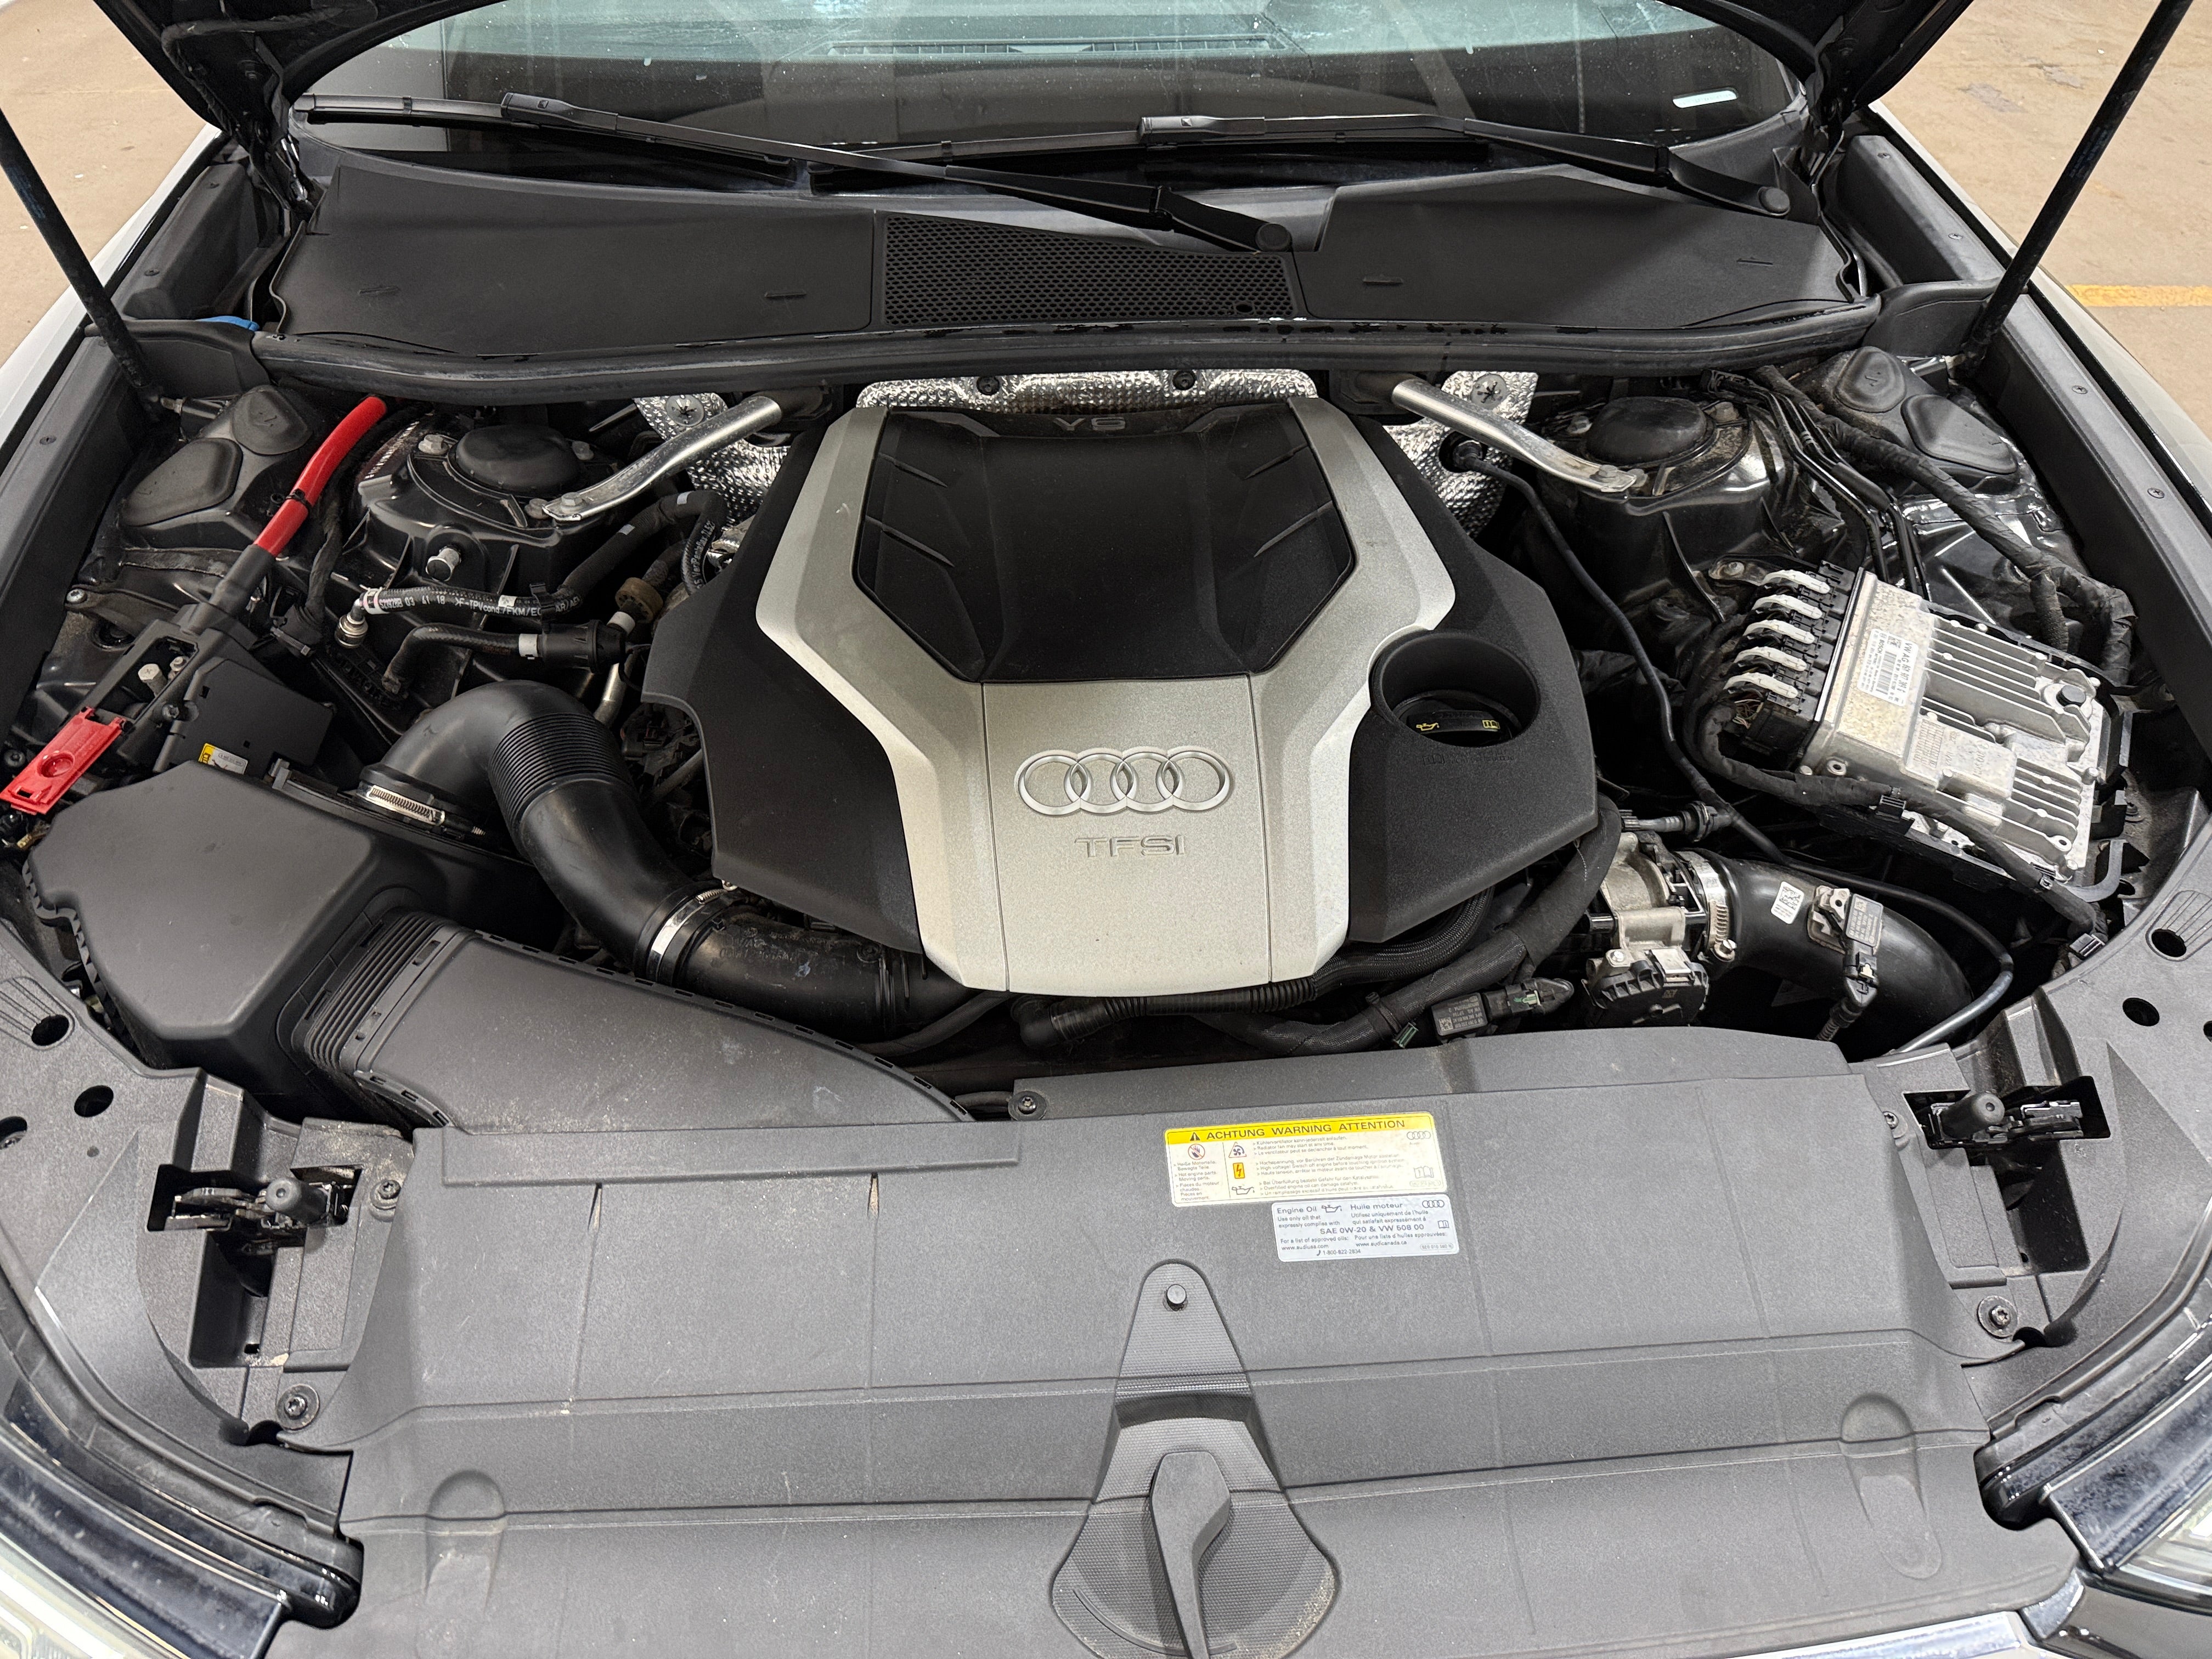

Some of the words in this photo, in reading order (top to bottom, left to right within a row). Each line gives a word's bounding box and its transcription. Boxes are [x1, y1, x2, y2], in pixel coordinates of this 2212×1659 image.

[1053, 417, 1126, 431] V6
[437, 595, 445, 605] 18
[1904, 642, 1912, 653] VW
[1901, 653, 1910, 663] AG
[1075, 834, 1186, 857] TFSI
[1206, 1128, 1265, 1140] ACHTUNG
[1272, 1124, 1331, 1135] WARNING
[1339, 1120, 1405, 1131] ATTENTION
